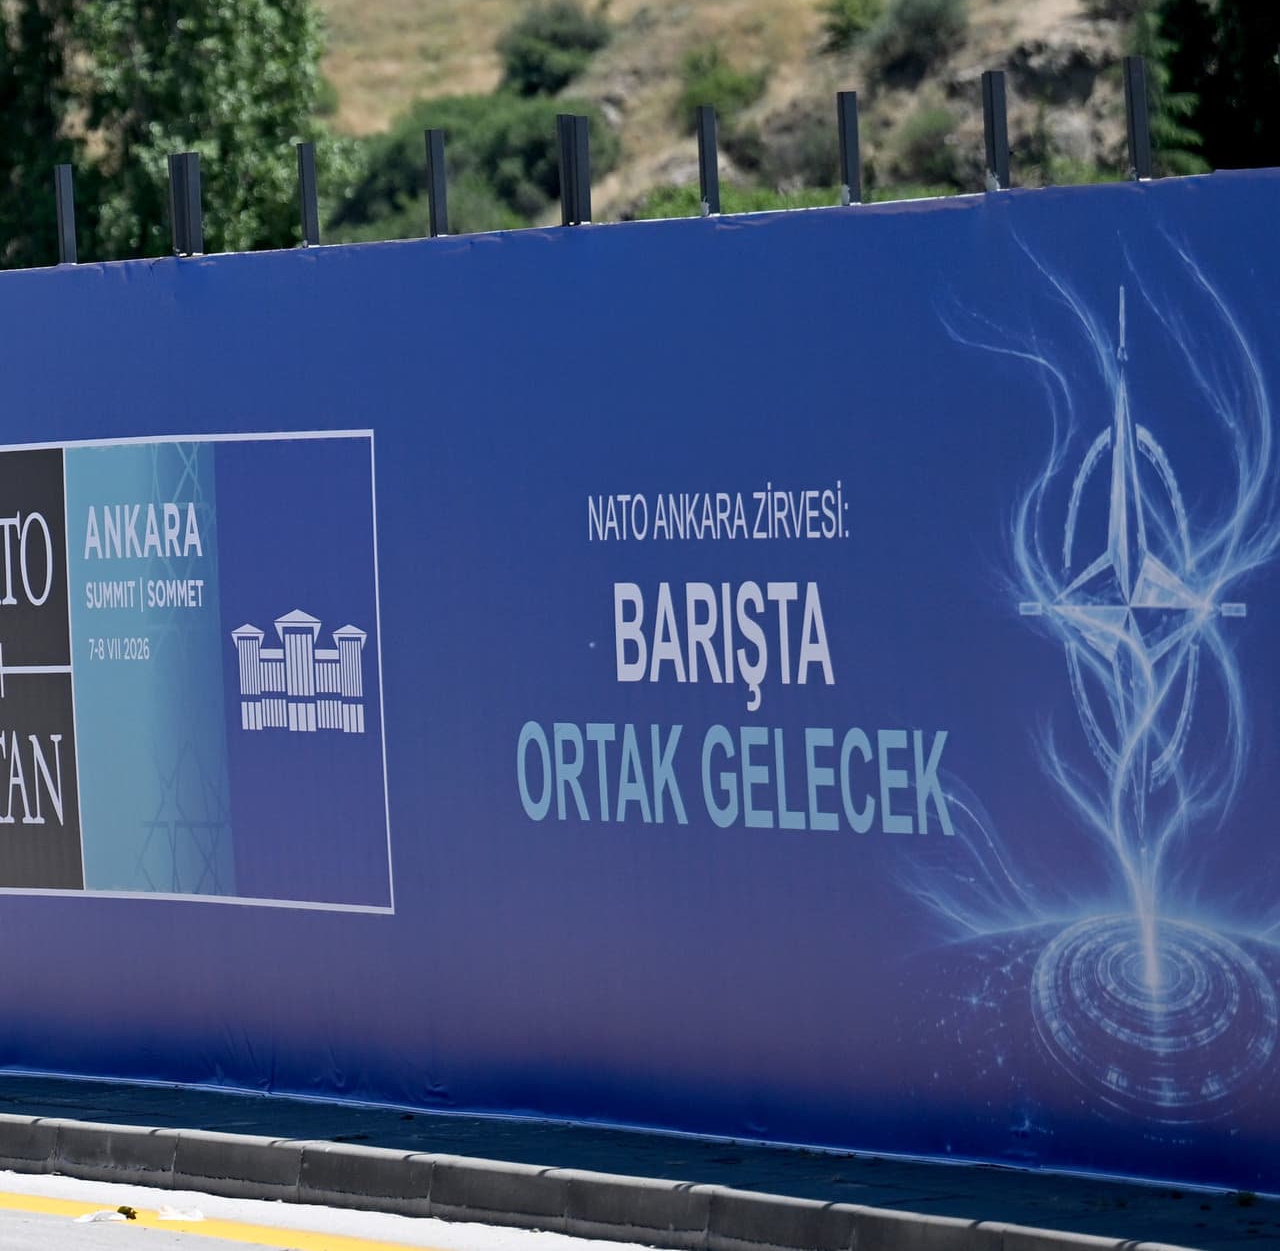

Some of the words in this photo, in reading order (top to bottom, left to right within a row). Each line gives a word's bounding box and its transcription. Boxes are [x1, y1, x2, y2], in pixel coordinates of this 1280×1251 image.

[84, 503, 203, 560] ANKARA
[588, 494, 648, 541] NATO
[653, 492, 748, 540] ANKARA
[752, 480, 850, 539] ZİRVESİ:
[85, 580, 135, 609] SUMMIT
[147, 580, 204, 608] SOMMET
[88, 638, 103, 659] 7-8
[105, 638, 121, 660] VII
[123, 637, 151, 660] 2026
[613, 580, 835, 712] BARIŞTA
[516, 720, 689, 825] ORTAK
[701, 724, 955, 836] GELECEK
